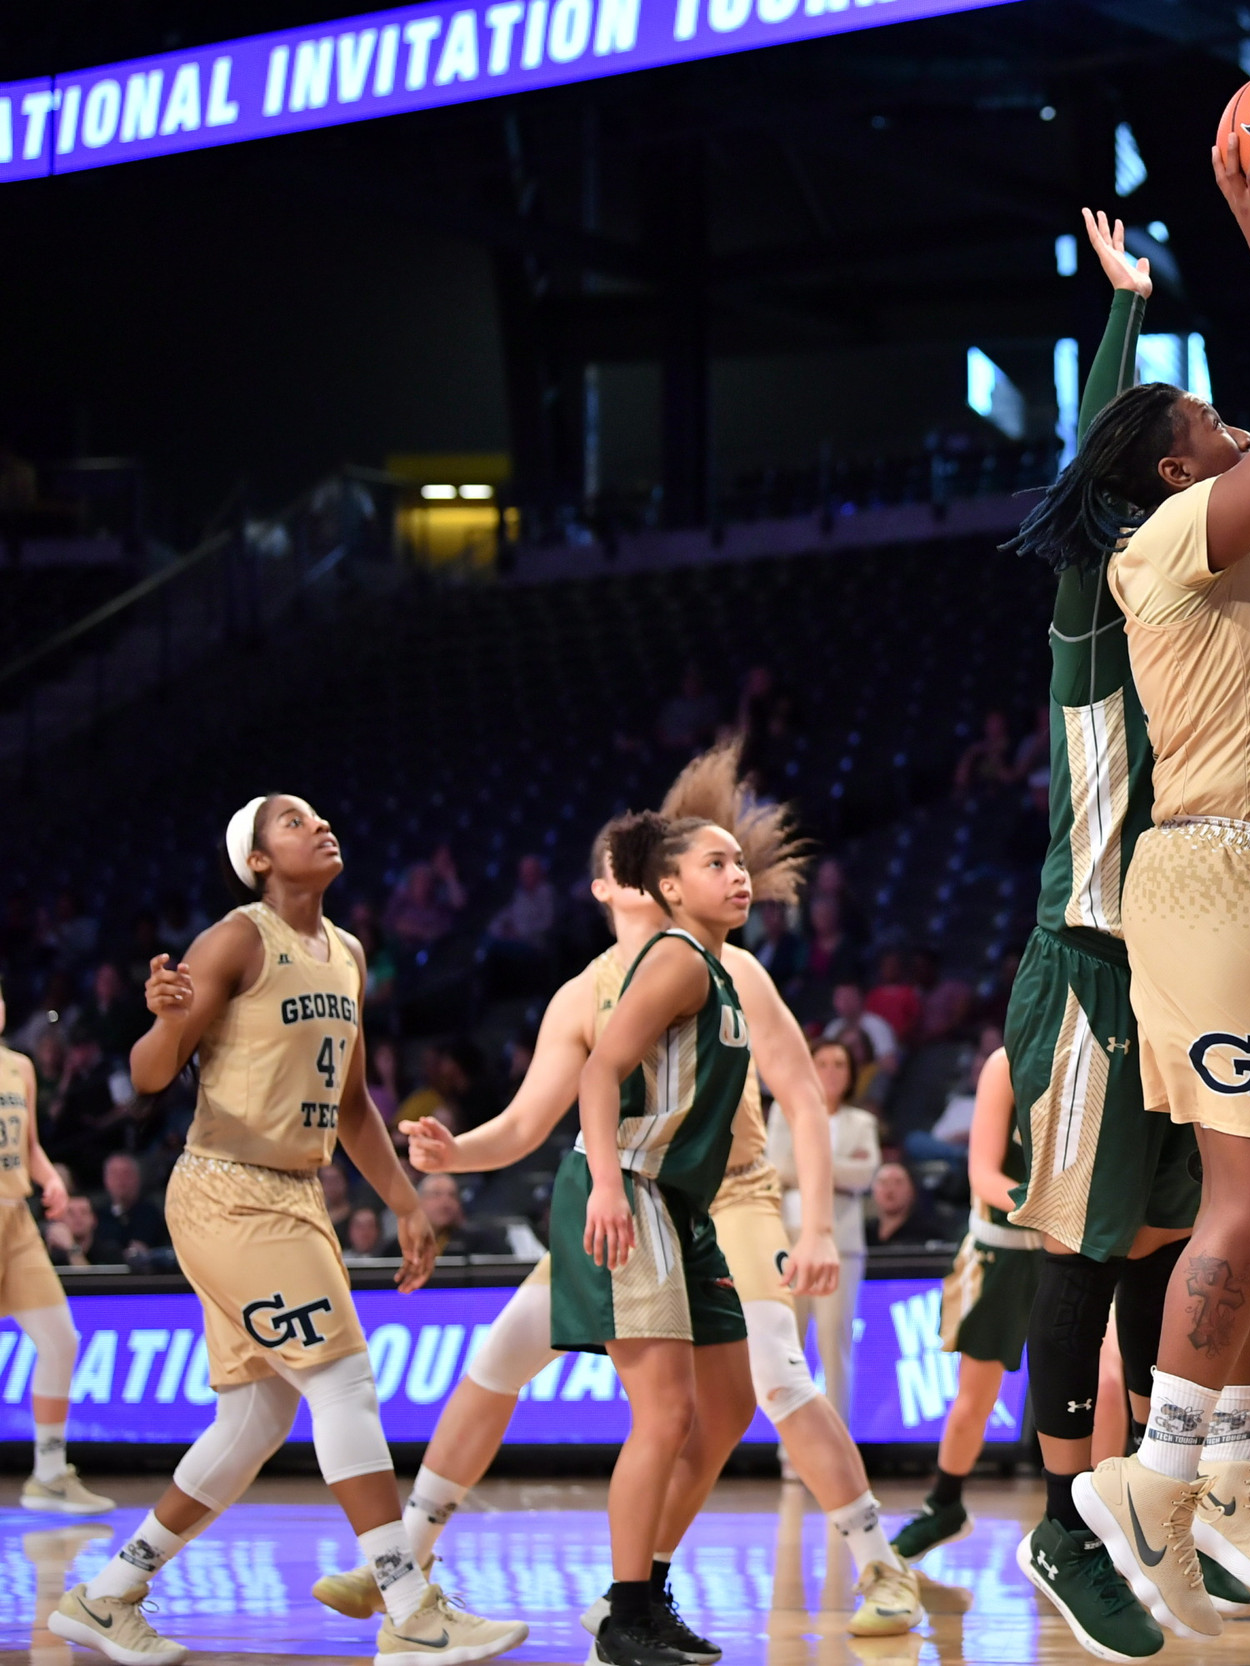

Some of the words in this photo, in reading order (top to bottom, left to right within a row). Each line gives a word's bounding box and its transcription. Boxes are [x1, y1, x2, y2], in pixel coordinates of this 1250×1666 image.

[262, 0, 642, 117] INVITATION
[281, 993, 358, 1026] GEORGI
[301, 1102, 339, 1129] TEC
[241, 1291, 333, 1350] GT
